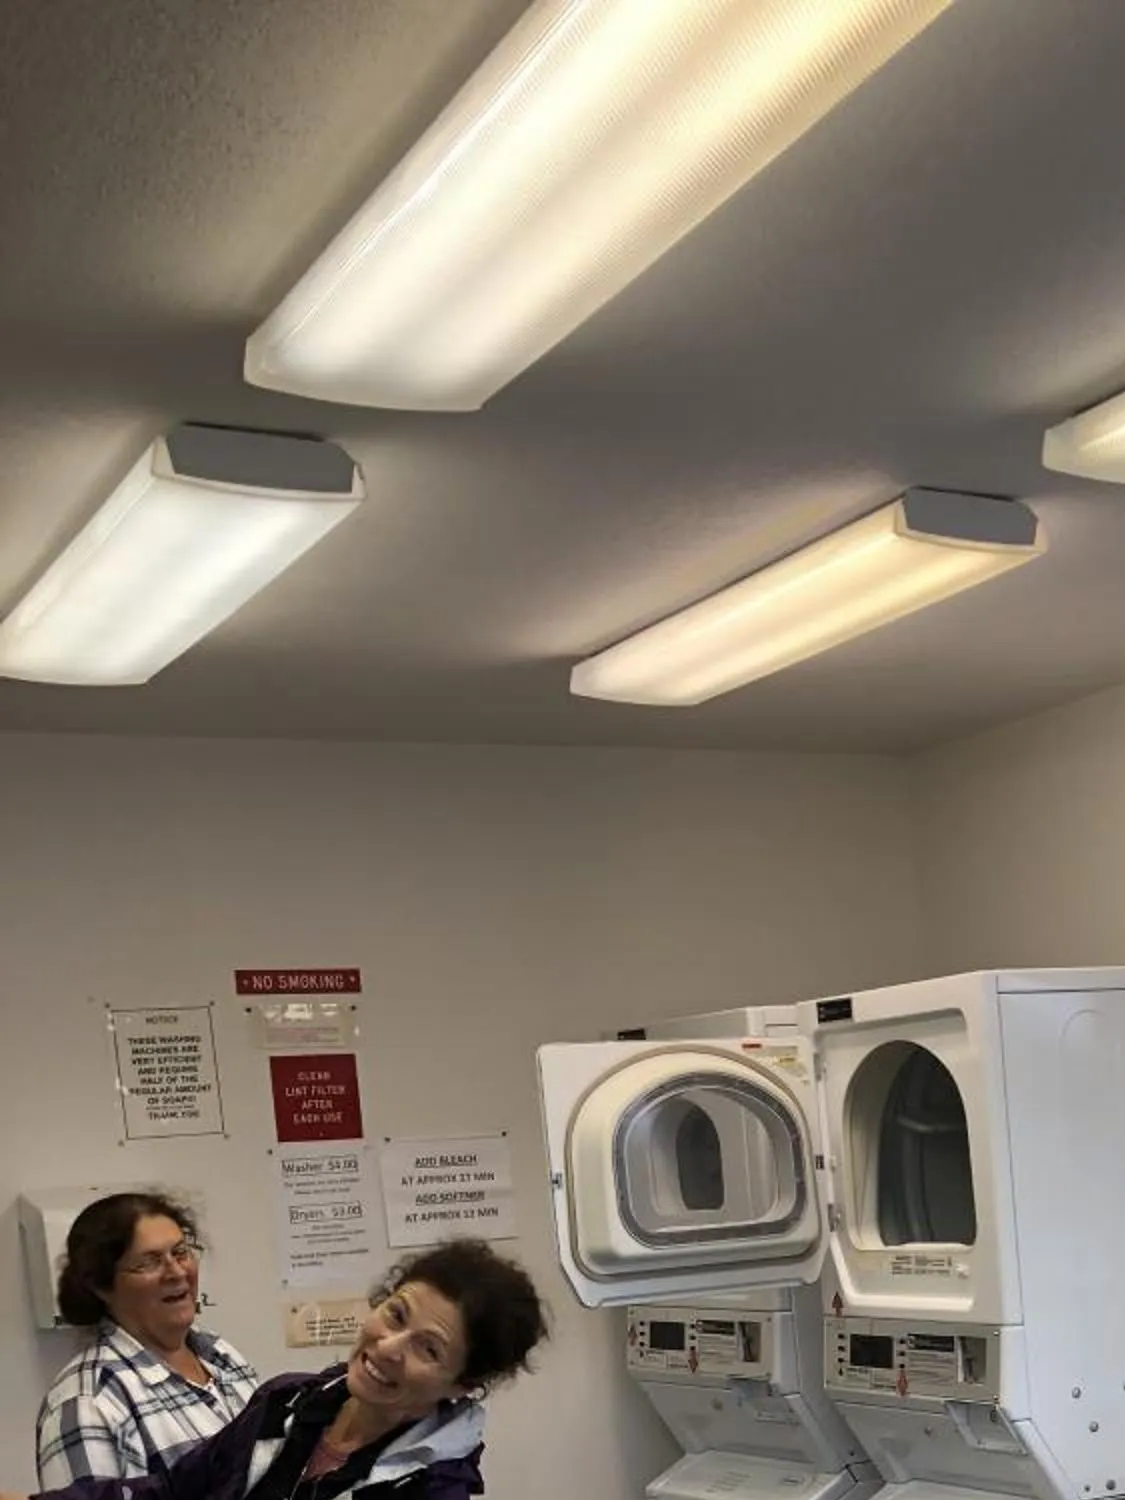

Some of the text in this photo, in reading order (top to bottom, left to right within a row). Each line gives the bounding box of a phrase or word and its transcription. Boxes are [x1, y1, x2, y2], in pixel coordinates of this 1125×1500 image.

[252, 974, 345, 990] NO SMOKING
[297, 1071, 332, 1082] CLEAN
[285, 1084, 346, 1097] LINT FILTER
[302, 1098, 333, 1110] AFTER
[149, 1111, 179, 1120] THANK
[293, 1111, 344, 1125] EACH USE
[282, 1160, 323, 1173] Washer
[415, 1154, 478, 1167] ADD BLEACH
[401, 1176, 414, 1187] AT
[417, 1174, 457, 1185] APPROX
[474, 1171, 495, 1182] MIN
[415, 1192, 437, 1205] ADD
[405, 1212, 418, 1224] AT
[421, 1210, 460, 1222] APPROX
[477, 1207, 499, 1218] MIN
